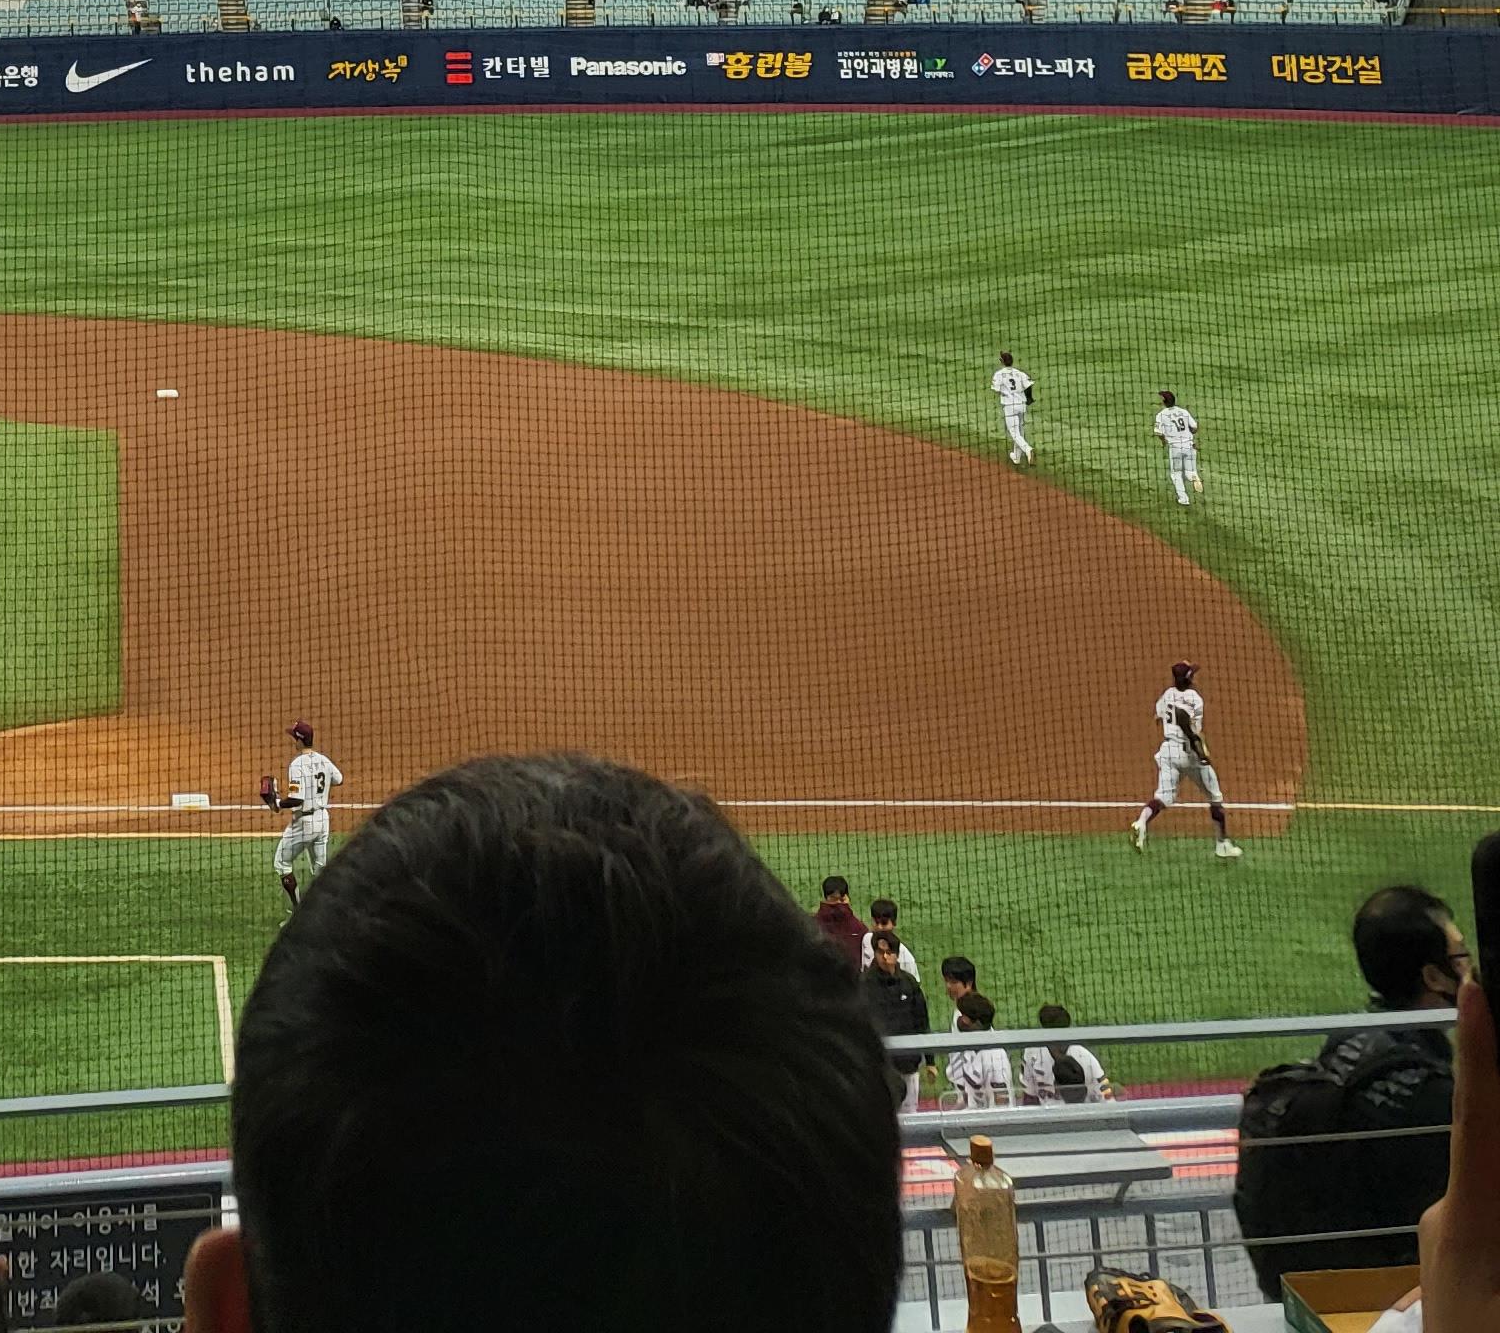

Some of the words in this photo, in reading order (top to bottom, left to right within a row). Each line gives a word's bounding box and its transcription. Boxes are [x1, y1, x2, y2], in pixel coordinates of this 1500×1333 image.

[186, 61, 295, 83] theham
[482, 55, 550, 79] 칸타빌
[569, 55, 687, 77] Panasonic
[721, 52, 813, 79] 홈런볼
[838, 58, 919, 79] 김안과병원
[995, 56, 1096, 79] 도미노피자
[1126, 53, 1228, 81] 금성백조
[1271, 54, 1383, 85] 대방건설
[50, 1239, 167, 1276] 자리입니다.
